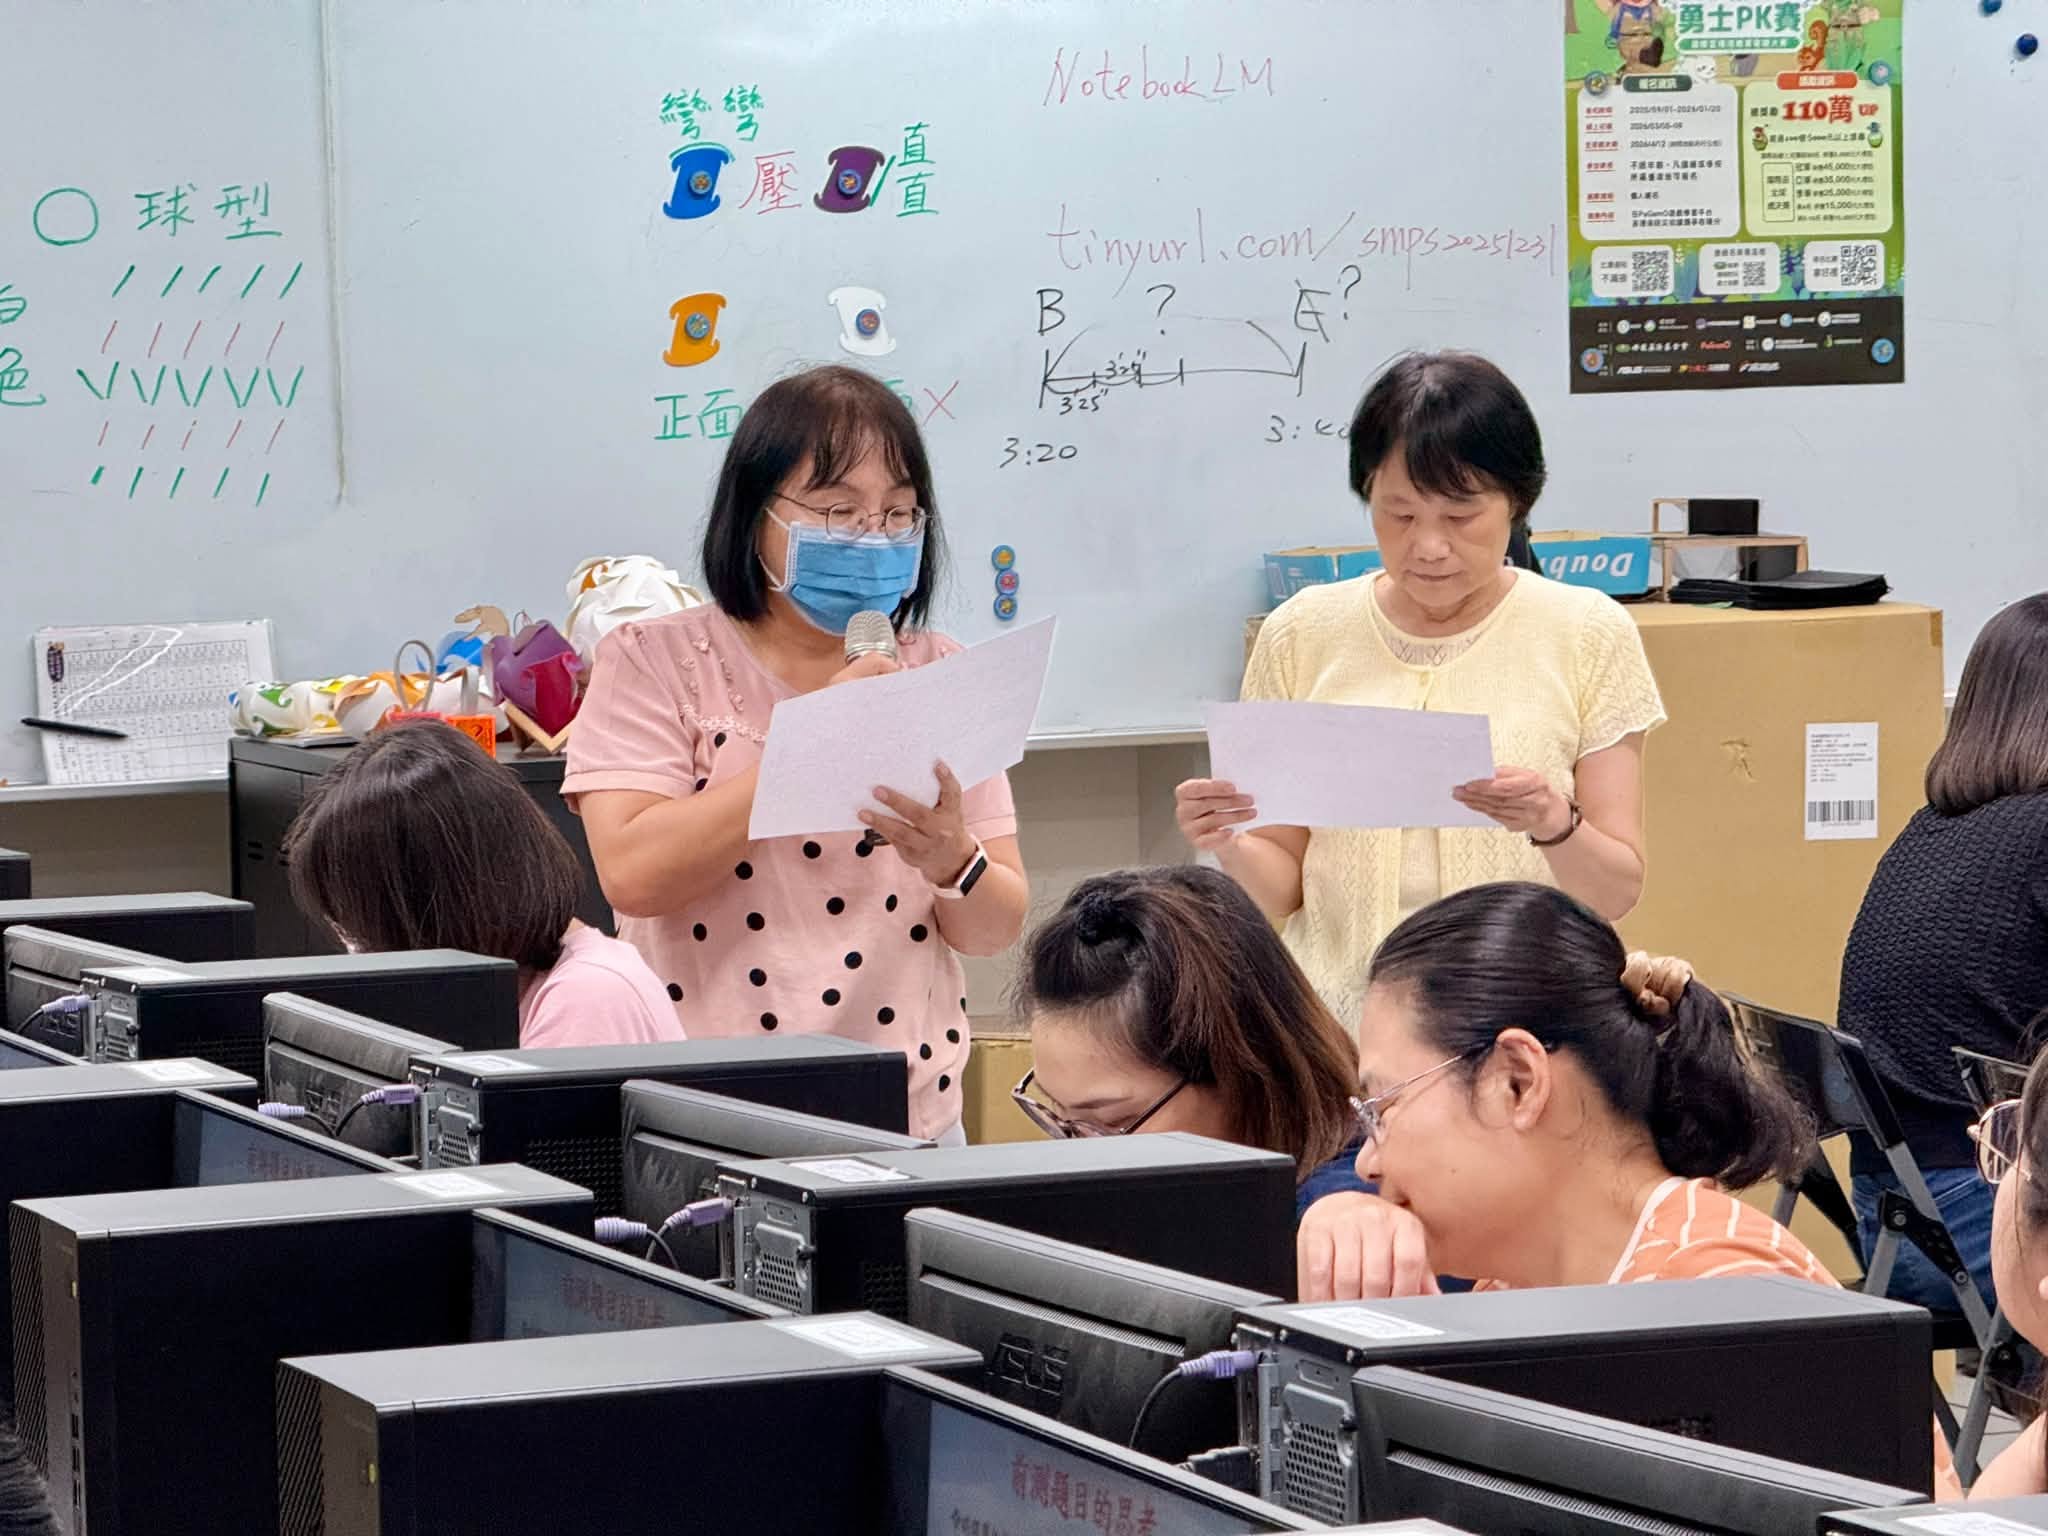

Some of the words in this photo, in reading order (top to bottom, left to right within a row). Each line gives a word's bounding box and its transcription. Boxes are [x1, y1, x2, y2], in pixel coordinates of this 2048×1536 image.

[1679, 2, 1801, 32] 勇士PK賽
[1782, 95, 1855, 124] 110萬
[1858, 104, 1879, 117] UP
[134, 181, 283, 240] 球型
[653, 388, 744, 441] 正面
[1000, 438, 1078, 468] 3:20
